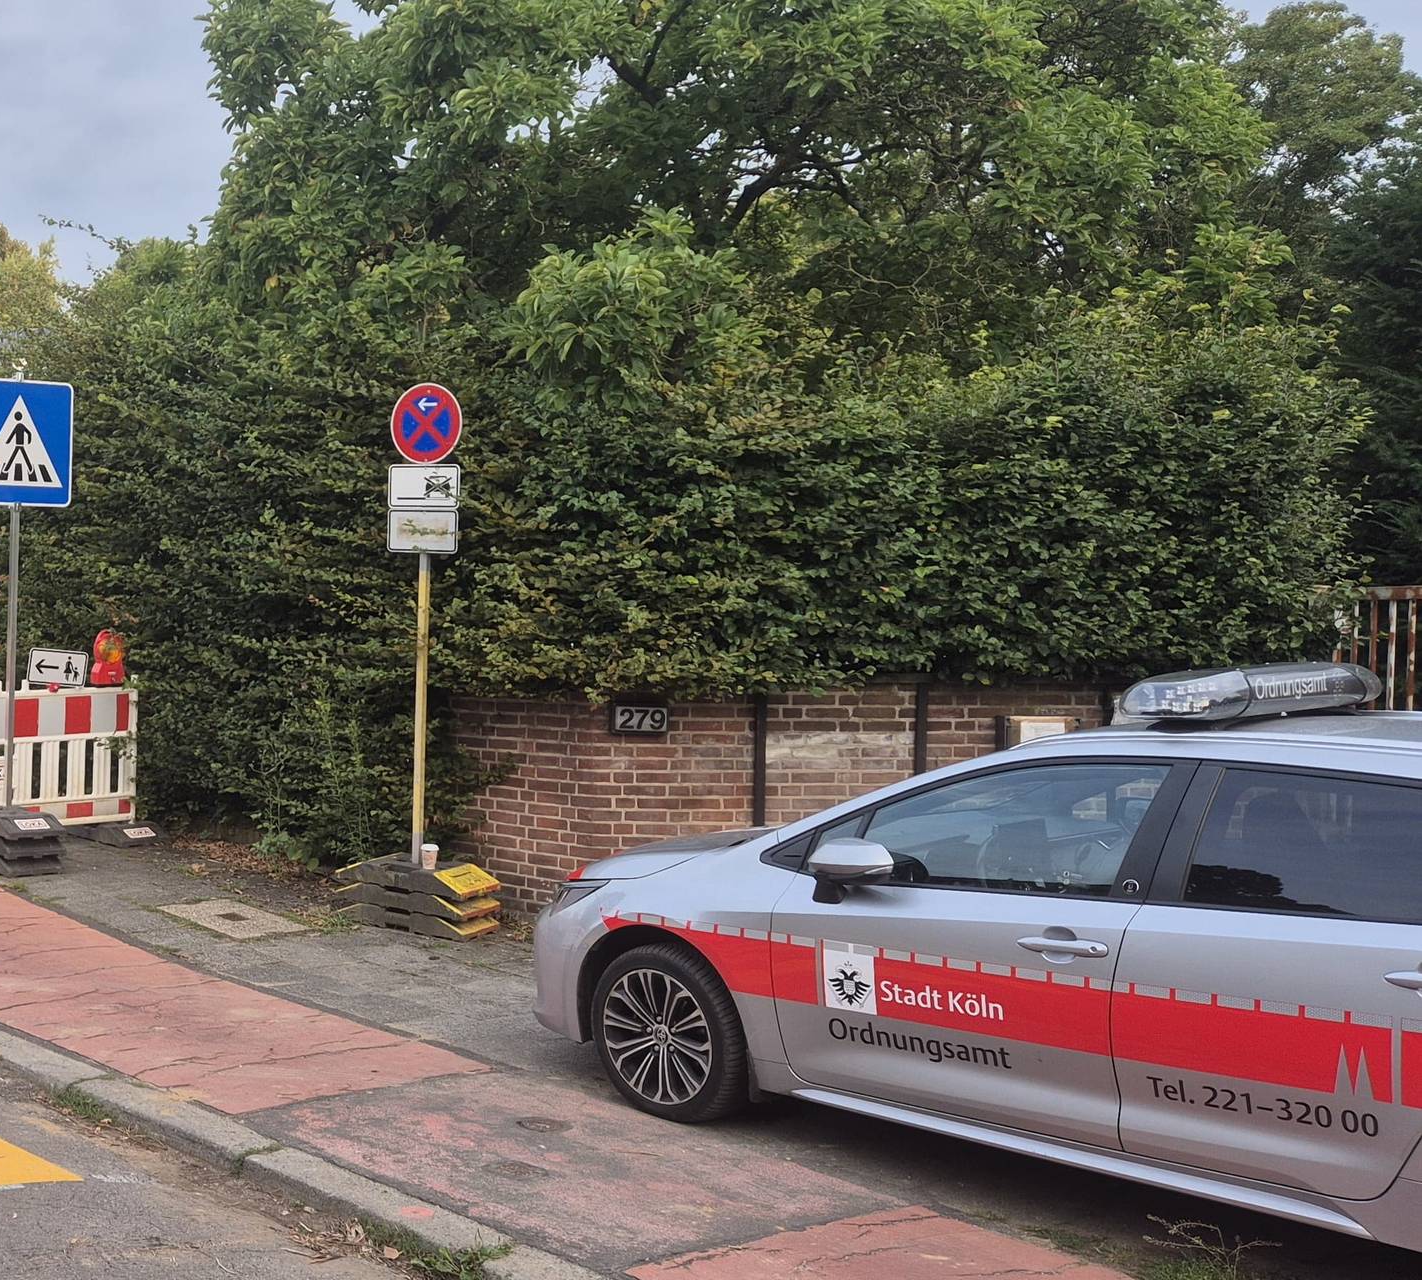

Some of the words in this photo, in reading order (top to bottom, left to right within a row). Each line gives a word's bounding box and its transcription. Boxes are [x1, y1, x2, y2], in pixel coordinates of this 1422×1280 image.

[1255, 672, 1328, 700] Ordnungsamt
[619, 708, 666, 730] 279
[879, 980, 943, 1010] Stadt
[948, 990, 1005, 1021] Köln
[828, 1017, 1012, 1069] Ordnungsamt
[1146, 1075, 1195, 1104] Tel.
[1341, 1109, 1379, 1138] 00
